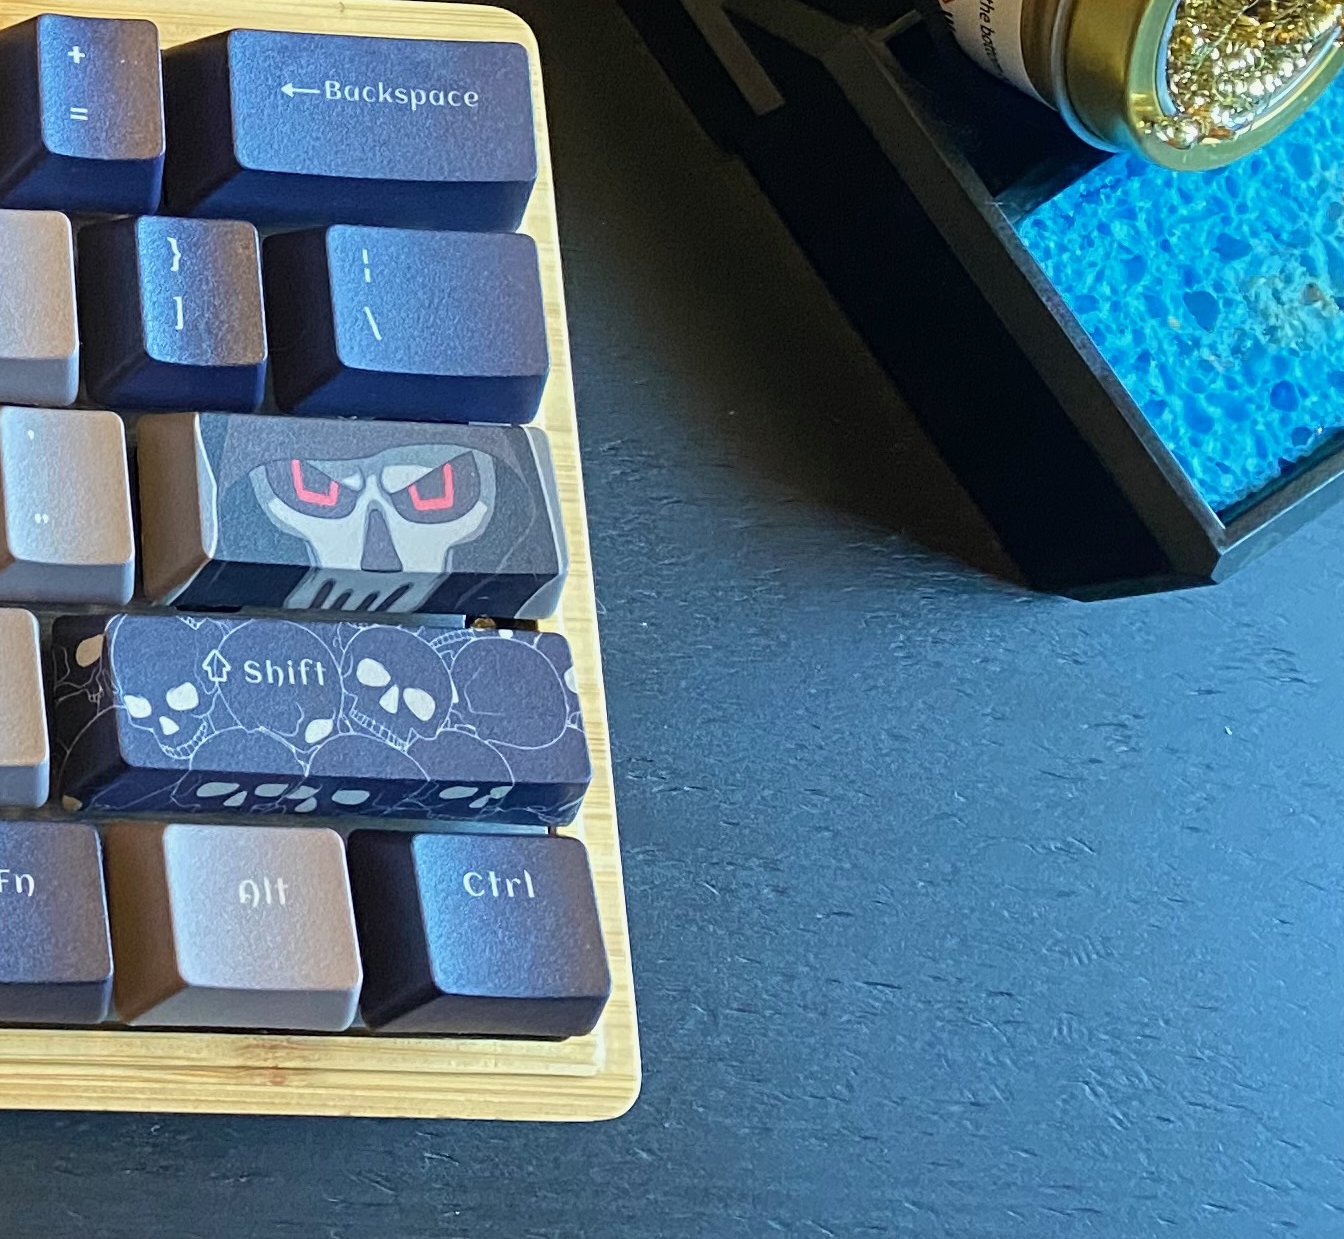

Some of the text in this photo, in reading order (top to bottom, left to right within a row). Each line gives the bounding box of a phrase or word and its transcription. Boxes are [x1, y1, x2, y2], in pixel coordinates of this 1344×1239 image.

[67, 45, 86, 64] +
[324, 80, 479, 113] Backspace
[69, 106, 89, 121] =
[166, 236, 182, 272] }
[172, 296, 184, 330] ]
[363, 306, 382, 341] \
[243, 658, 326, 687] Shift
[238, 876, 289, 908] Alt
[462, 869, 535, 898] Ctrl
